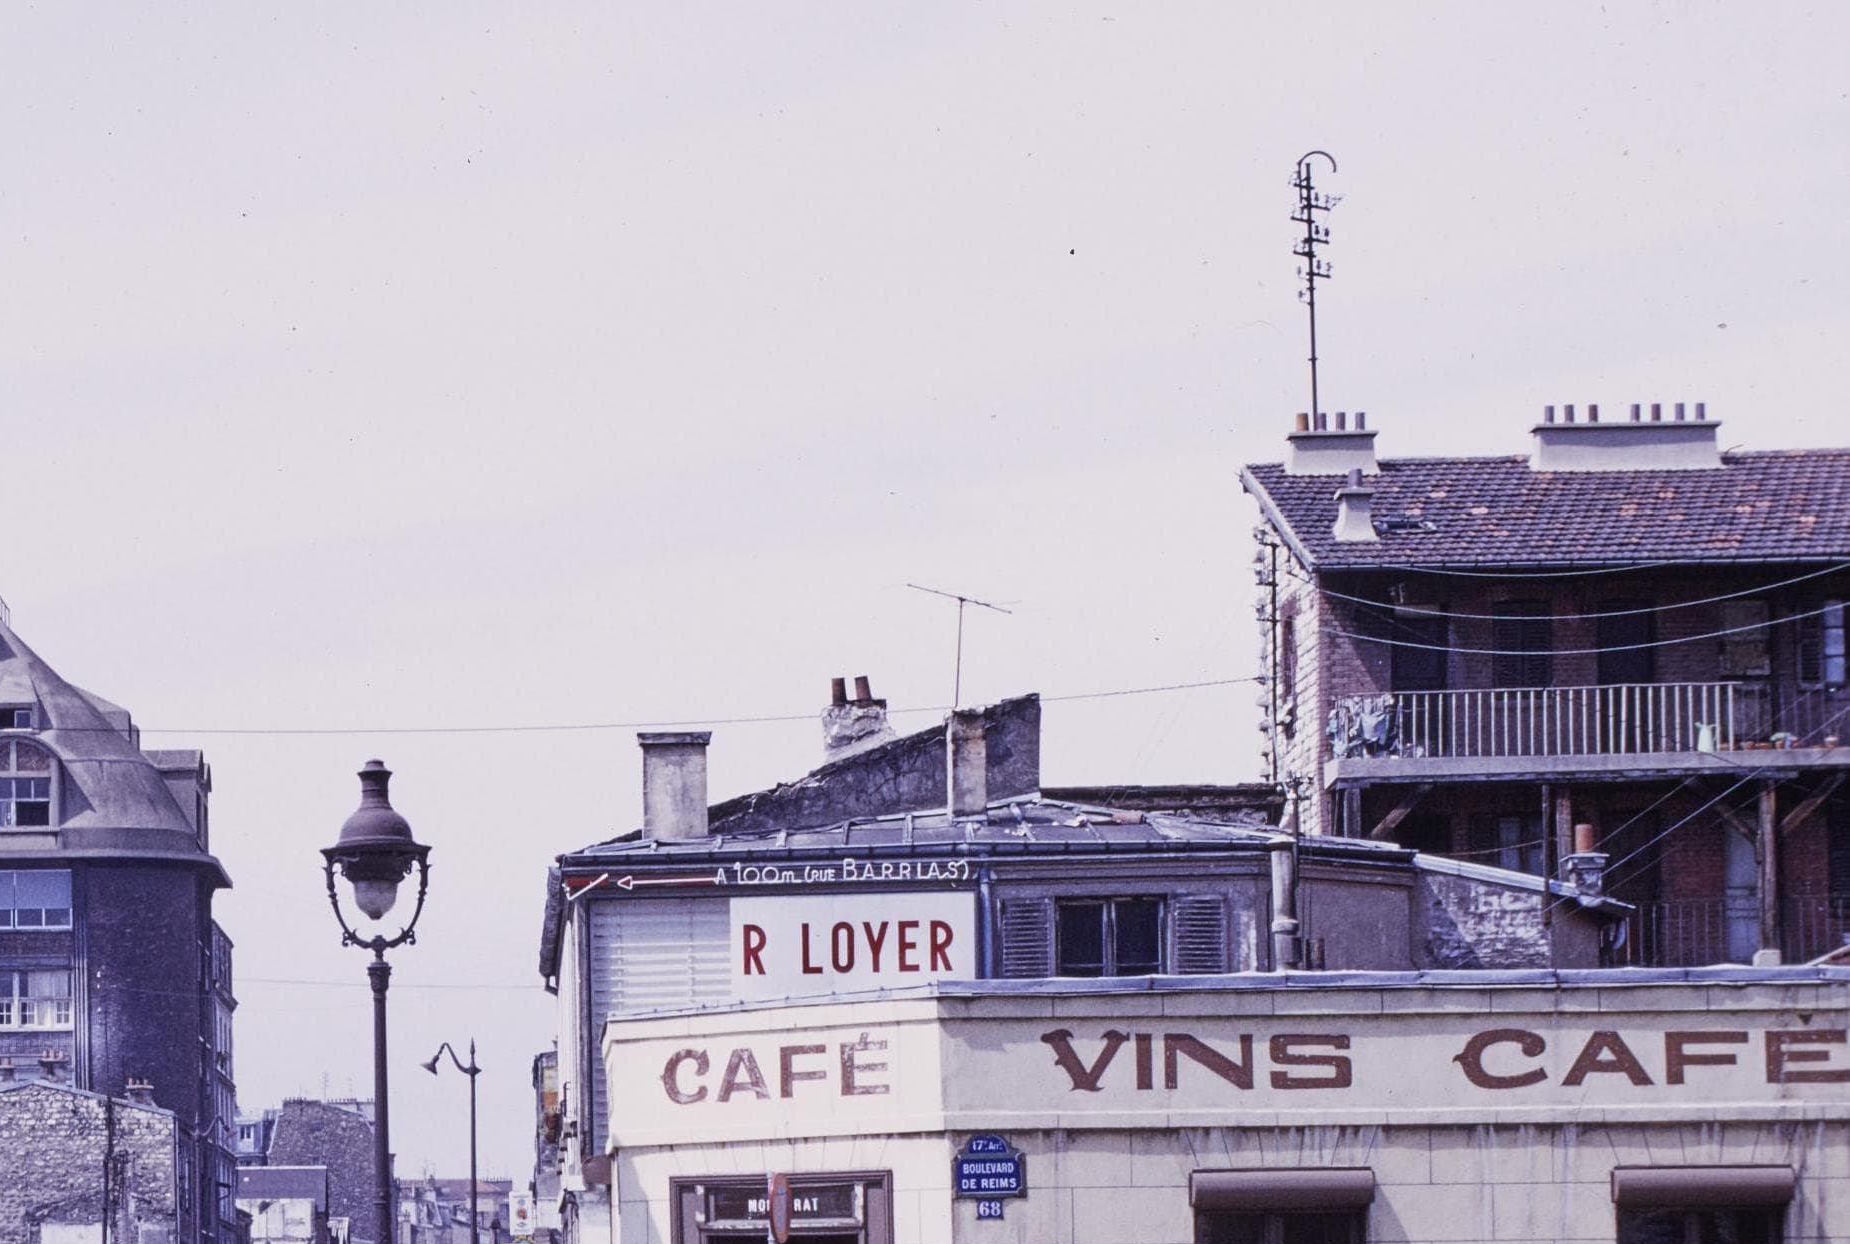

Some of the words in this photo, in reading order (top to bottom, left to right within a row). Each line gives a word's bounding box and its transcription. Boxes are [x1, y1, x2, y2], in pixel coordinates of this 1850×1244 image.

[743, 924, 766, 975] R
[802, 920, 953, 974] LOYER
[1041, 1028, 1353, 1092] VINS
[963, 1162, 1014, 1174] BOULEVARD
[961, 1178, 977, 1189] DE
[981, 1177, 1017, 1189] REIMS
[979, 1201, 1001, 1217] 68
